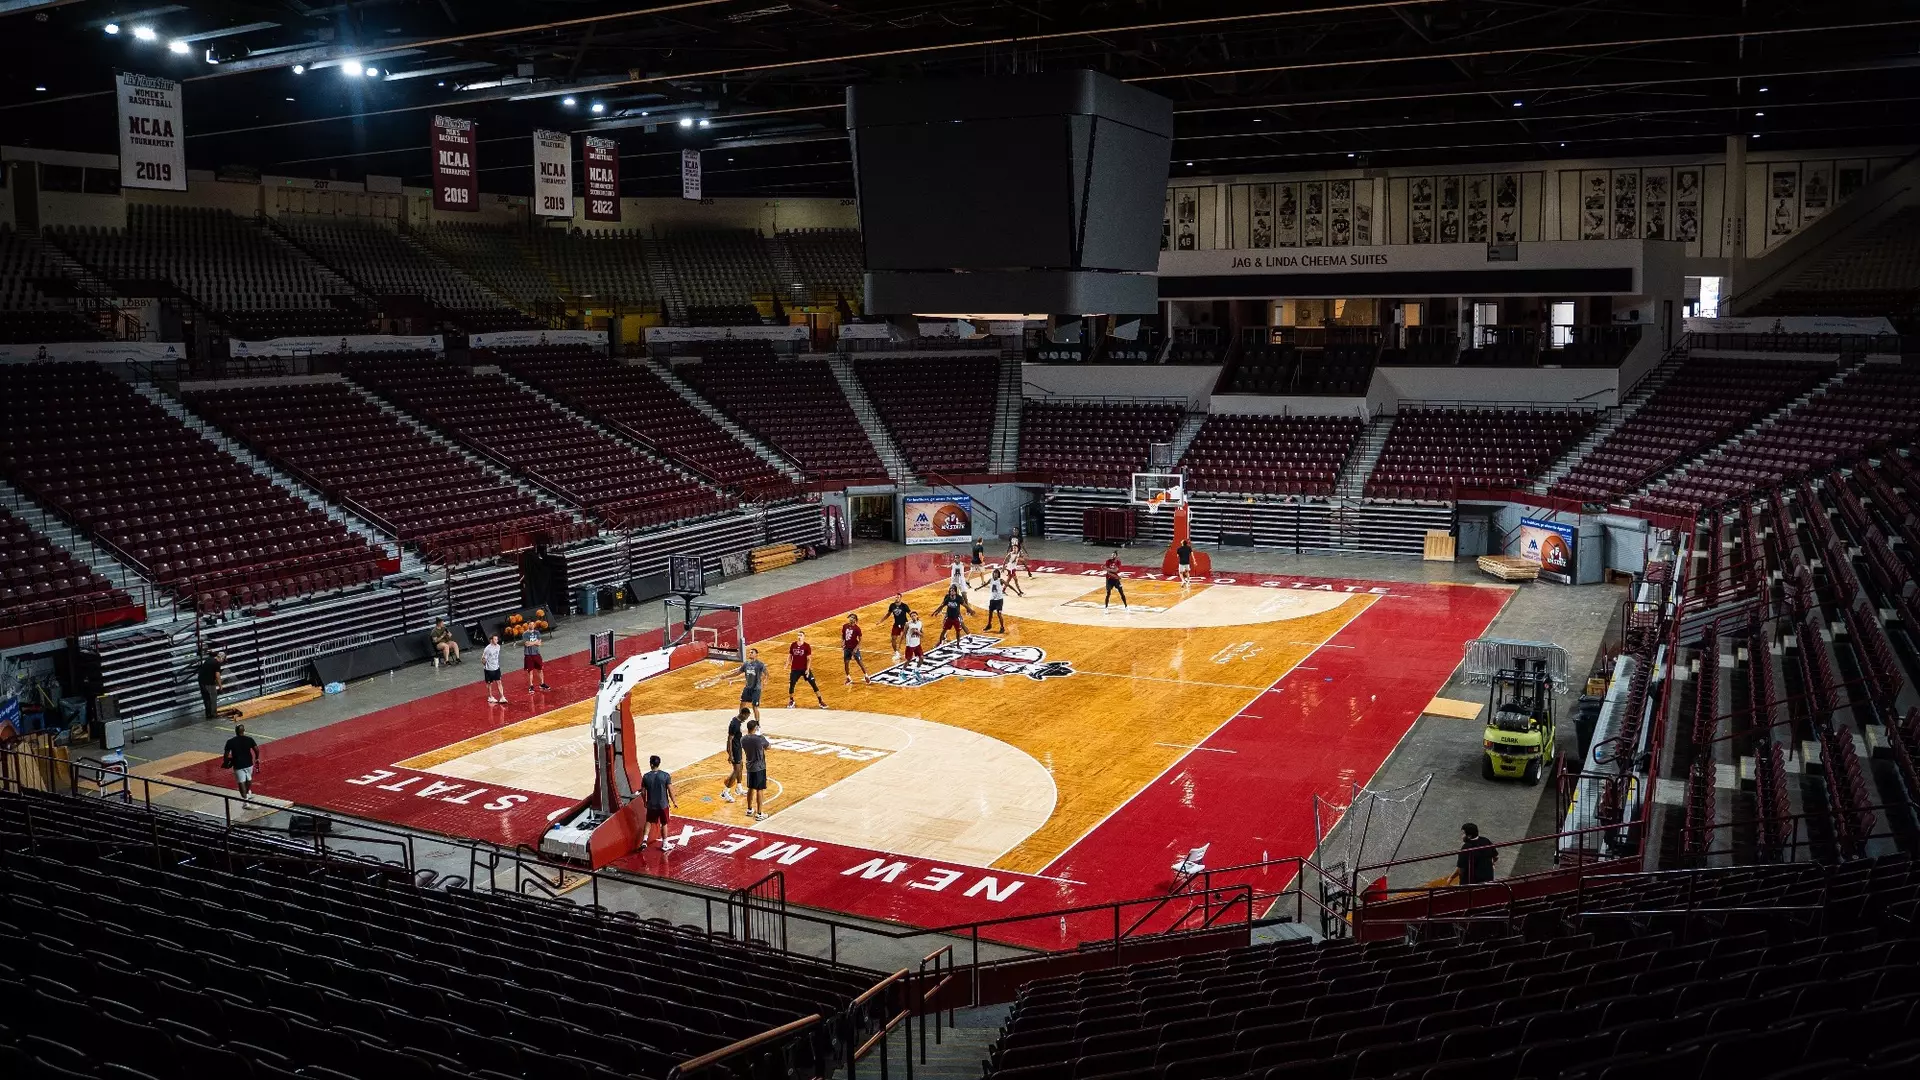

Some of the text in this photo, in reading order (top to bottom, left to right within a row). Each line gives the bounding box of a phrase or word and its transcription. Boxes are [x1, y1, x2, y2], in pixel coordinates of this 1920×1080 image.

[135, 88, 164, 99] WOMEN'S
[128, 96, 173, 108] BASKETBALL
[129, 116, 174, 137] NCAA
[130, 136, 174, 148] TOURNAMENT
[438, 134, 469, 144] BASKETBALL
[439, 150, 470, 168] NCAA
[136, 161, 172, 181] 2019
[440, 167, 470, 176] TOURNAMENT
[540, 162, 566, 177] NCAA
[589, 167, 614, 182] NCAA
[314, 180, 329, 189] 207
[444, 187, 469, 203] 2019
[544, 196, 565, 210] 2019
[592, 200, 613, 214] 2022
[1232, 254, 1388, 268] JAG & LINDA CHEEMA SUITES
[122, 299, 152, 307] LOBBY
[1260, 581, 1391, 595] STATE
[1501, 736, 1519, 744] CLARK
[344, 769, 530, 811] STATE
[839, 857, 1026, 903] NEW
